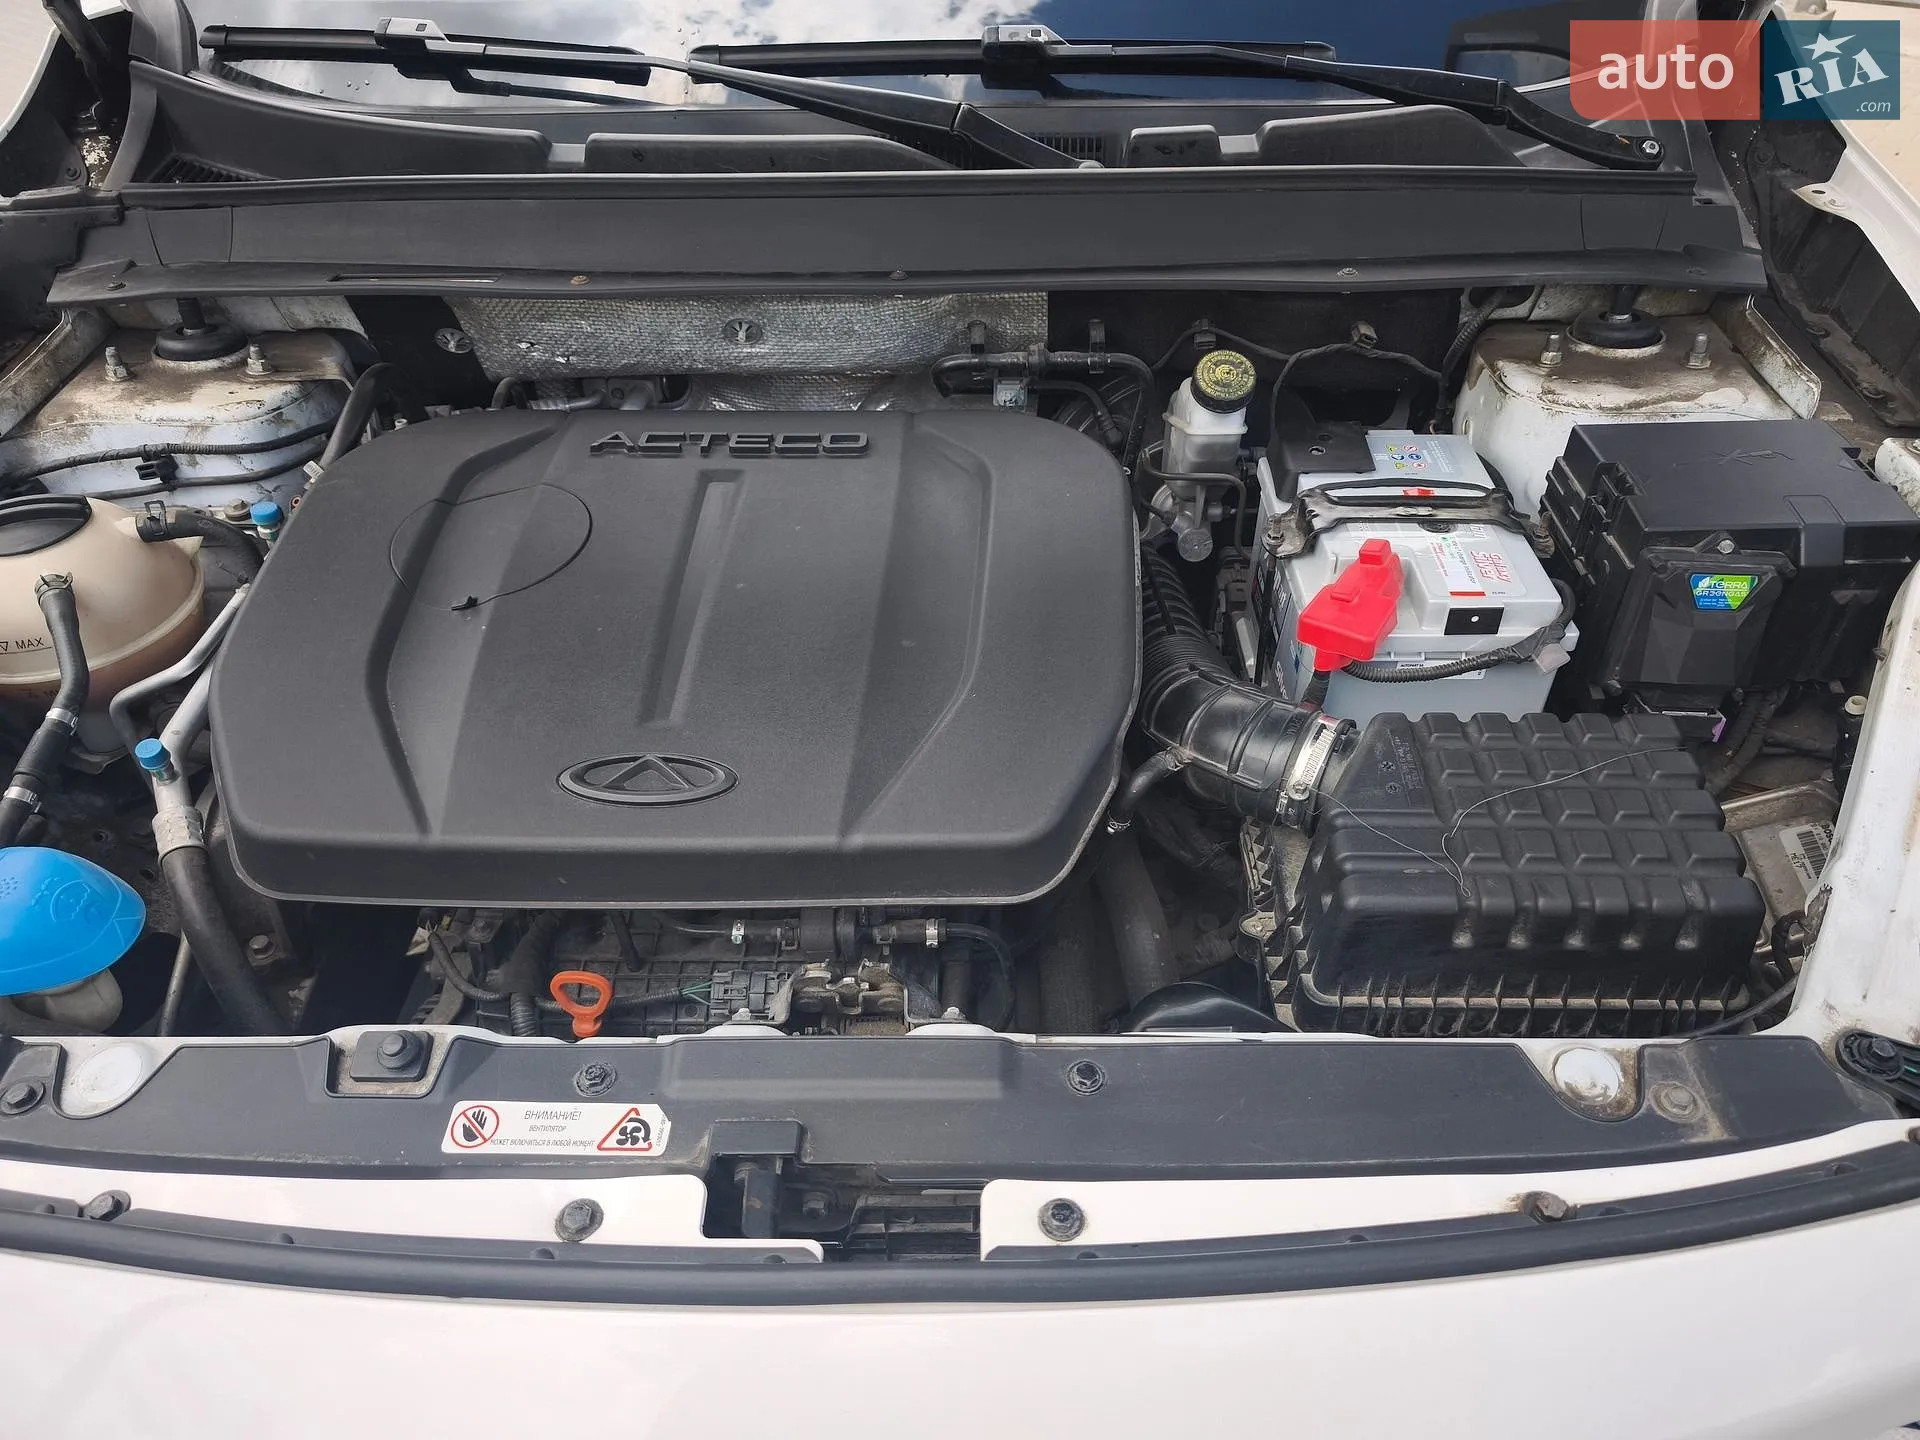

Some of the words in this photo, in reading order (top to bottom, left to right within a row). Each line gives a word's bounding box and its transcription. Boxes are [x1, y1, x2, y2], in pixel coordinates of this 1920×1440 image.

[589, 430, 870, 458] ACTECO
[15, 637, 45, 649] MAX
[524, 1110, 582, 1121] ВНИМАНИЕ!
[528, 1124, 567, 1132] ВЕНТИЛЯТОР
[551, 1138, 572, 1146] ЛЮБОЙ
[571, 1139, 595, 1147] МОМЕНТ
